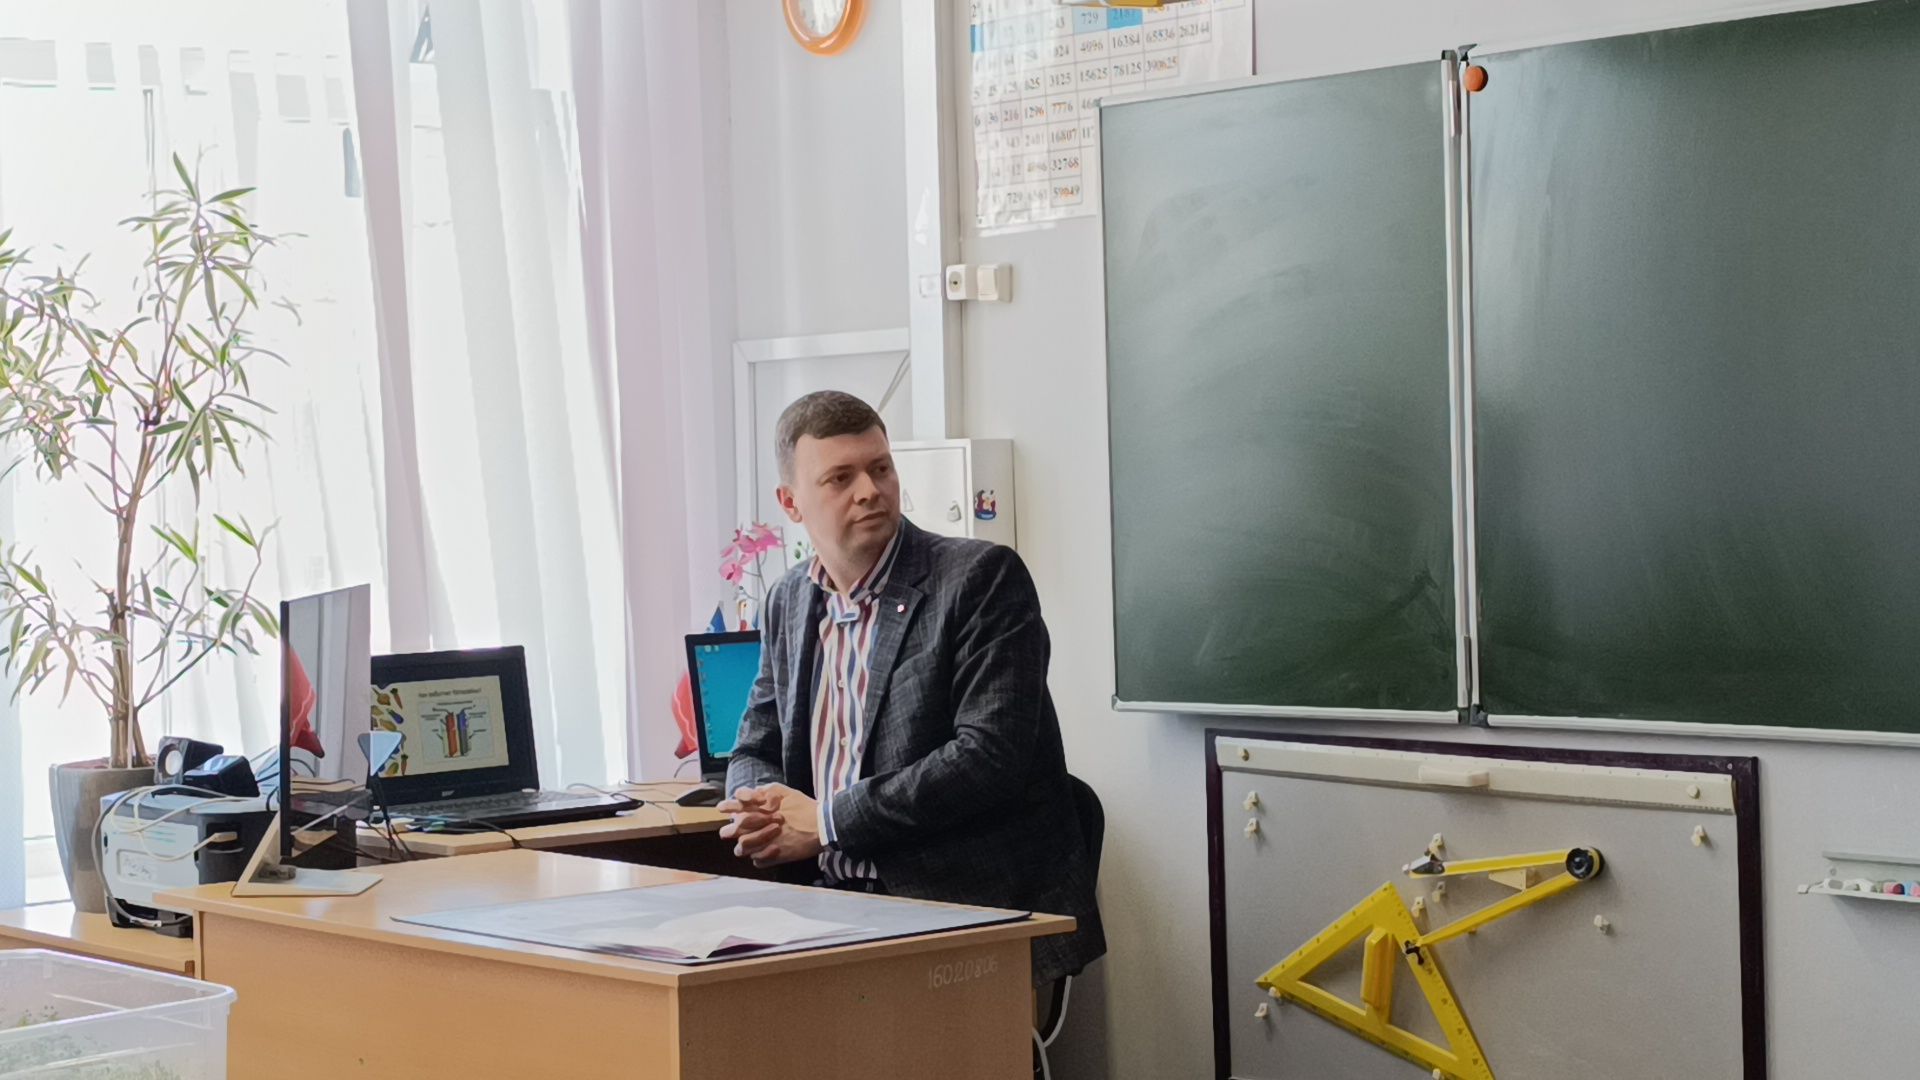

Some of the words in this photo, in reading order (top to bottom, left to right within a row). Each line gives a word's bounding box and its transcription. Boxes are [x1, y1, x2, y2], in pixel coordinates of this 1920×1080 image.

[1112, 32, 1141, 49] 16384
[1145, 27, 1175, 43] 65536
[1049, 72, 1072, 87] 3125
[1079, 67, 1108, 82] 15625
[1113, 62, 1142, 77] 78125
[1052, 101, 1073, 115] 7776
[1051, 128, 1078, 144] 16807
[1050, 157, 1080, 171] 32768
